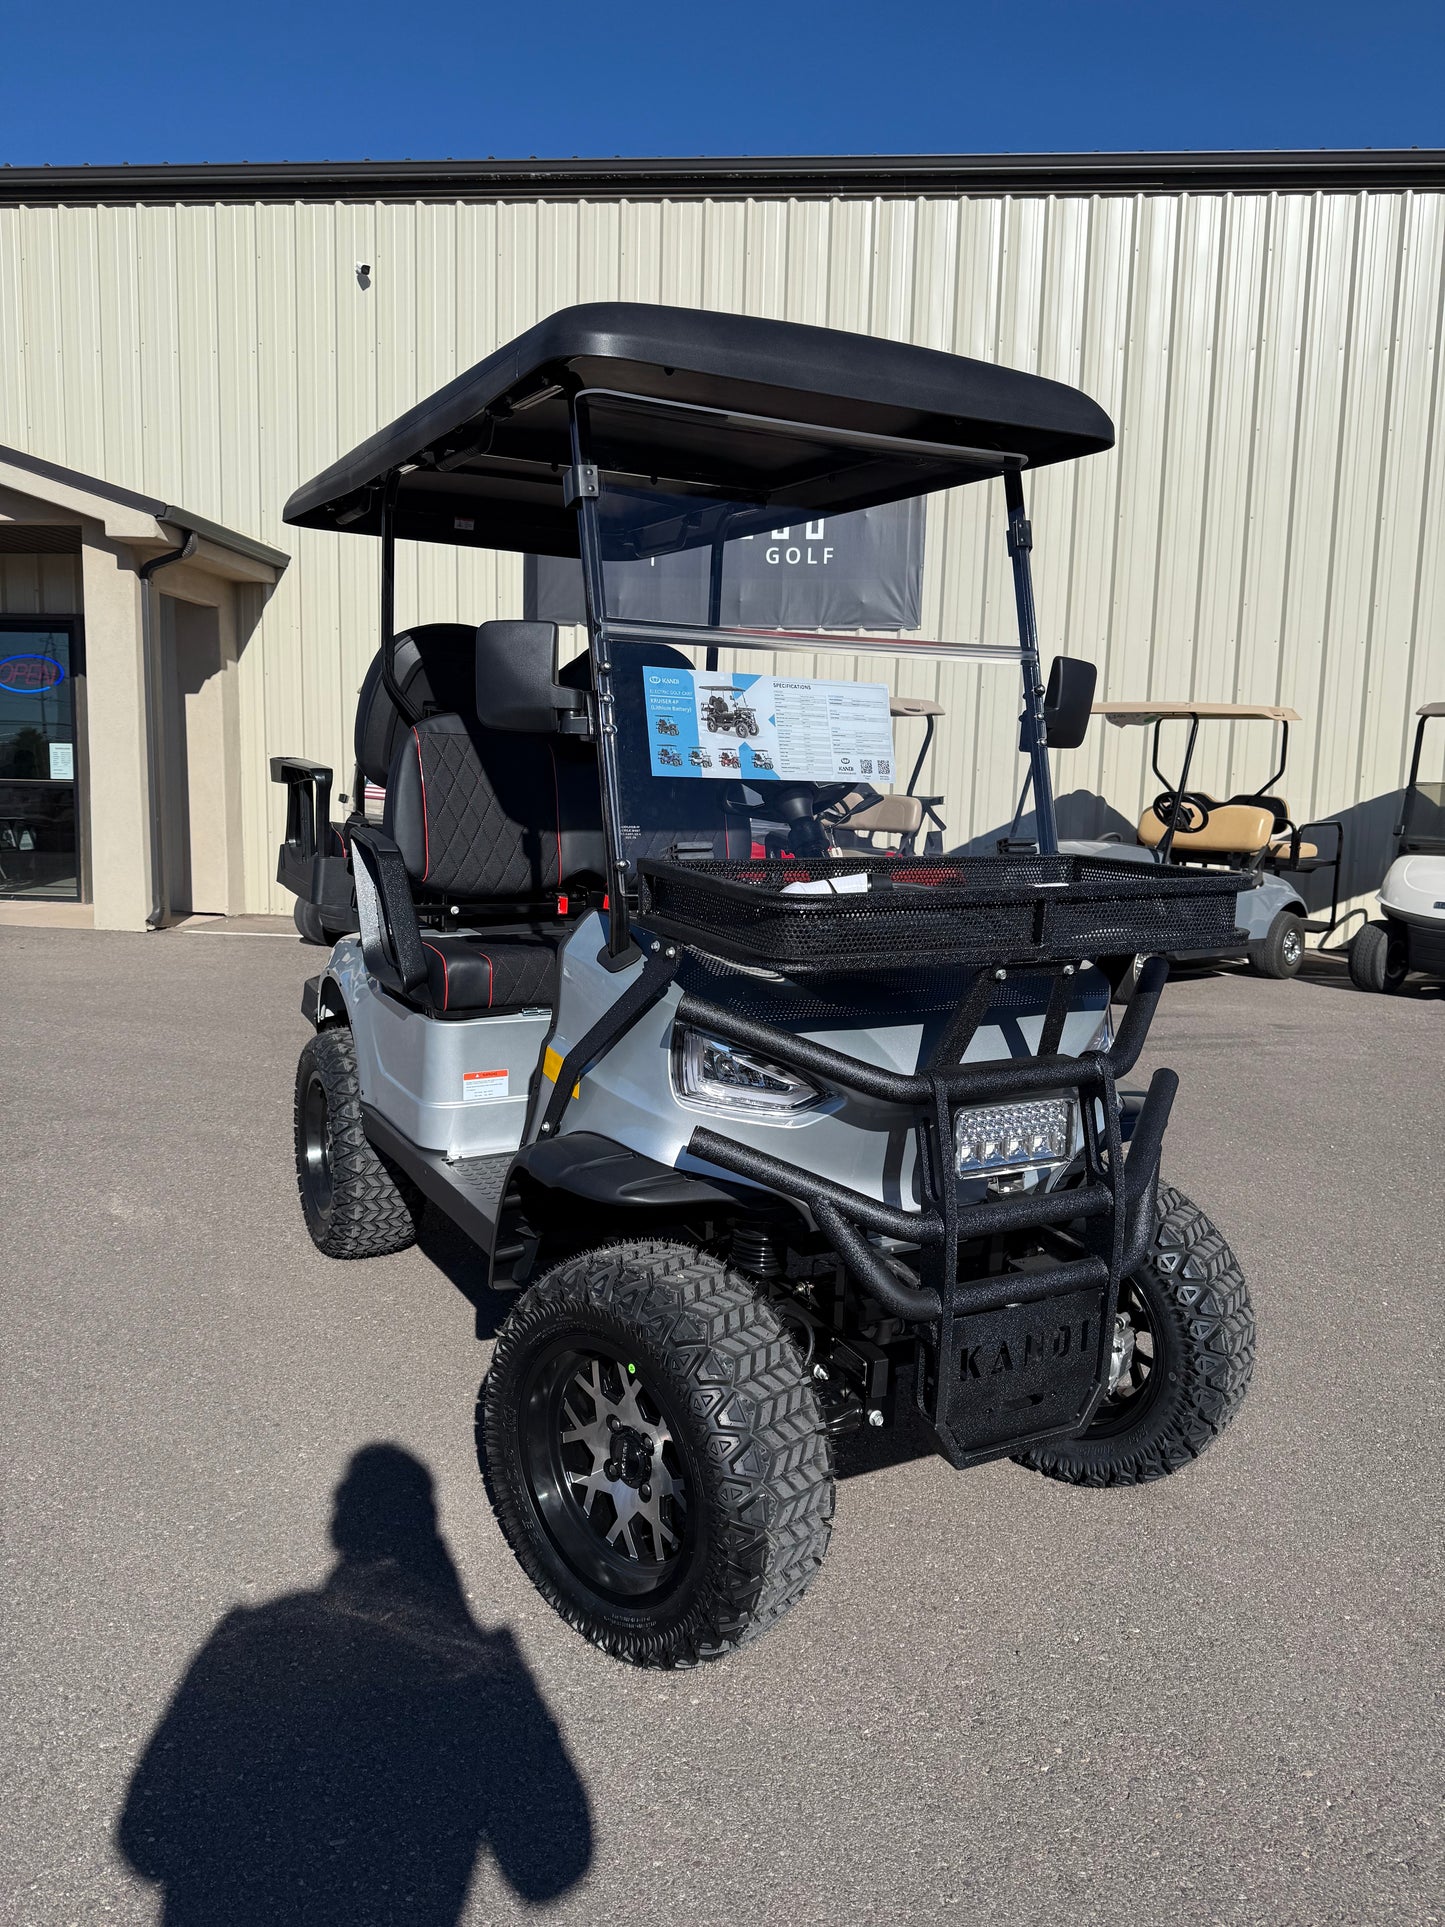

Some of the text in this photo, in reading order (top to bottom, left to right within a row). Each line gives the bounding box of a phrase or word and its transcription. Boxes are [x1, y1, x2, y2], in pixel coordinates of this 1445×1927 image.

[765, 547, 834, 565] GOLF
[0, 663, 57, 685] OPEN
[773, 682, 812, 690] SPECIFICATIONS
[672, 705, 692, 713] Battery)
[959, 1319, 1090, 1382] KANDI
